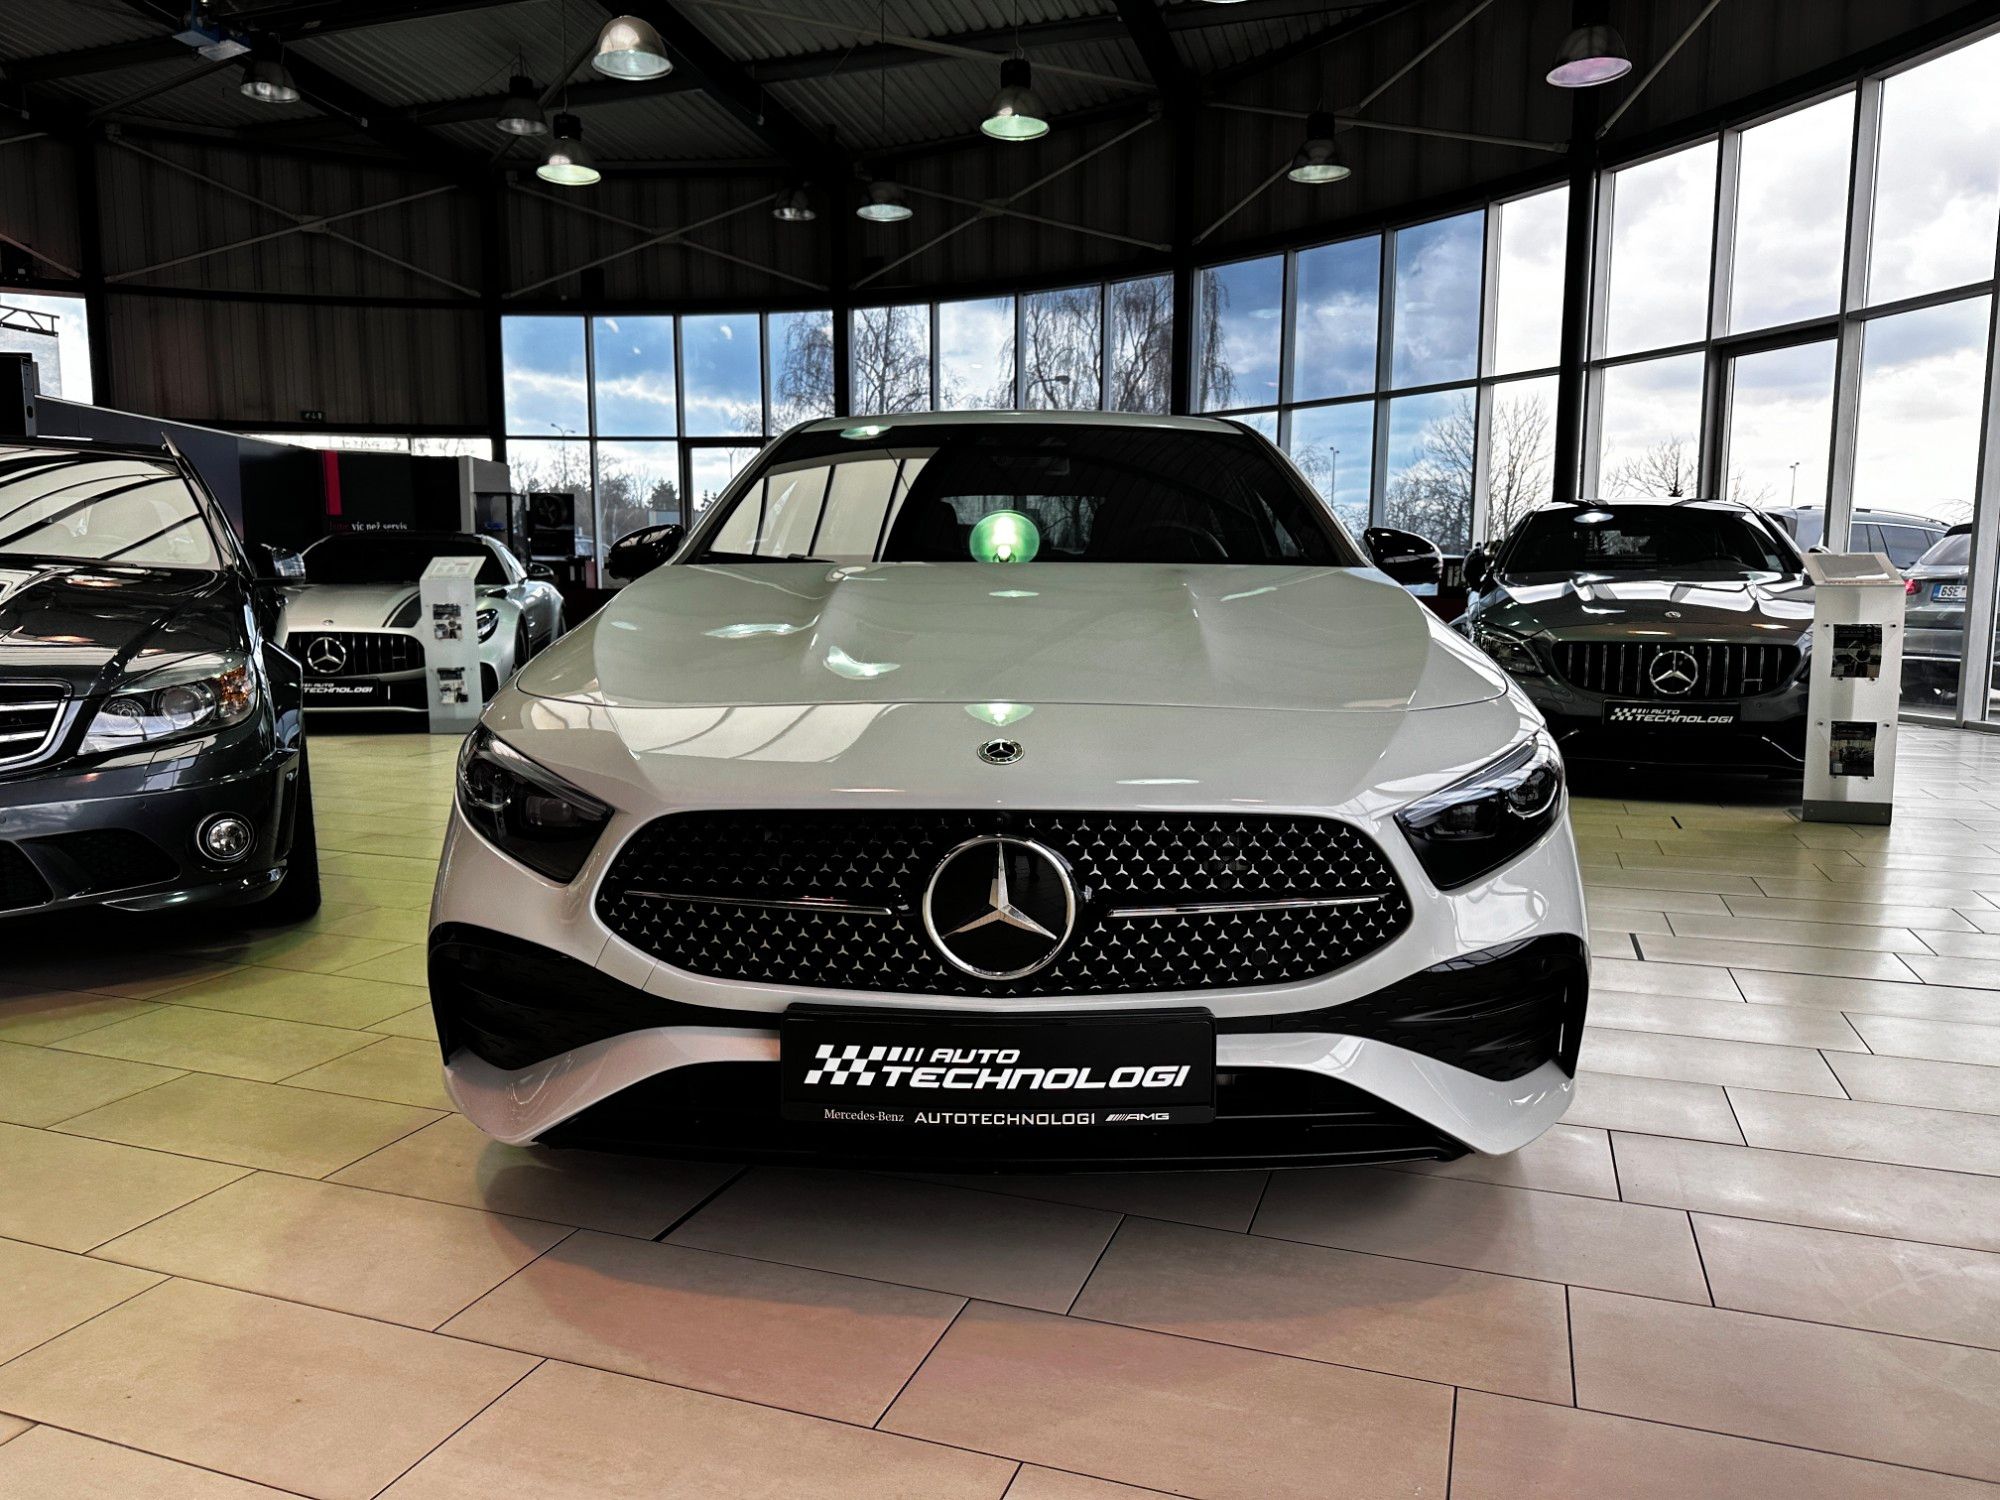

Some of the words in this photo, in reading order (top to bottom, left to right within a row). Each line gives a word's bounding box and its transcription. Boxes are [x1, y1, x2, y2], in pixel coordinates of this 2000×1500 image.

[1635, 714, 1733, 723] TECHNOLOGI
[929, 1048, 1020, 1064] AUTO
[881, 1065, 1191, 1090] TECHNOLOGI
[824, 1109, 905, 1122] Mercedes-Benz
[914, 1112, 1095, 1125] AUTOTECHNOLOGI
